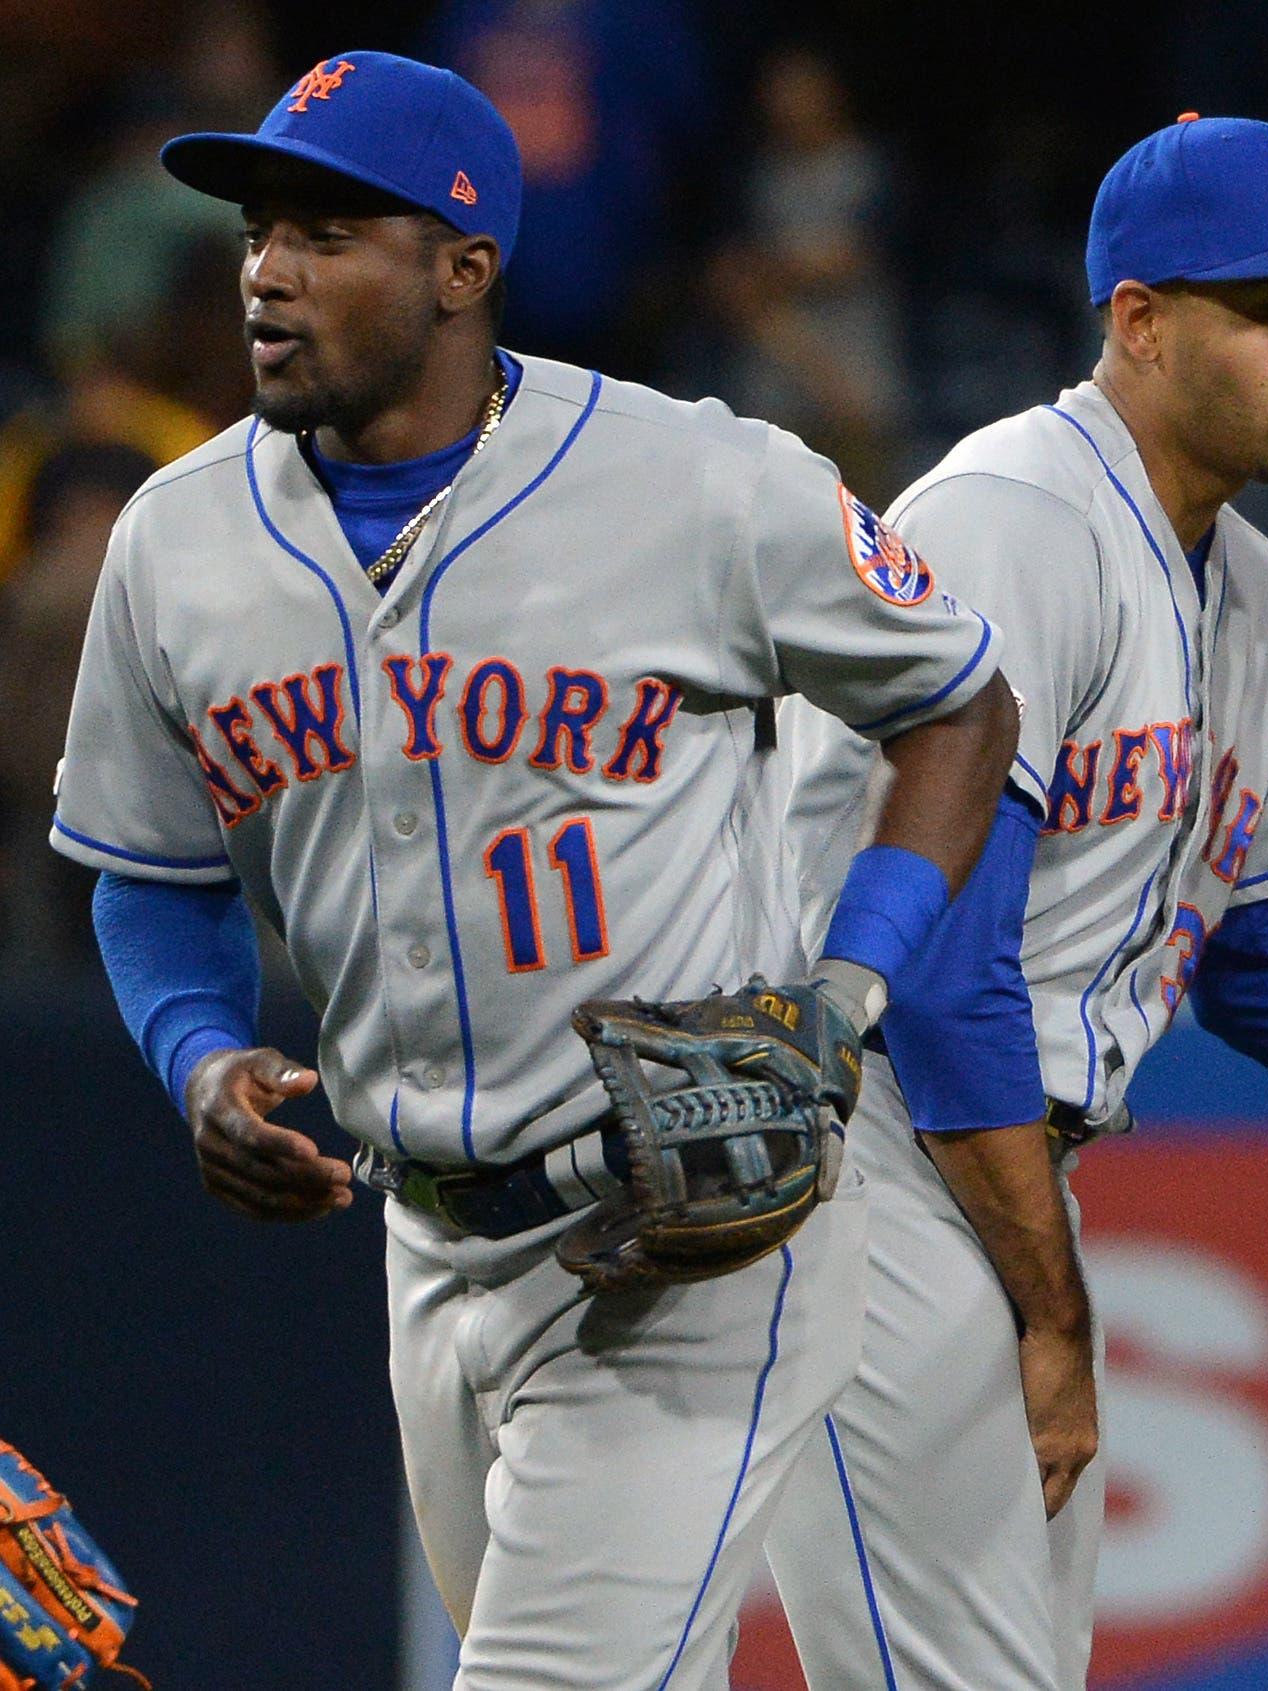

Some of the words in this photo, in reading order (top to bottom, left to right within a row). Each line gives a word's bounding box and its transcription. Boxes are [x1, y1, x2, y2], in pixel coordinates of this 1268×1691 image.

[381, 651, 684, 785] YORK
[483, 816, 610, 974] 11
[1160, 901, 1218, 1030] 3
